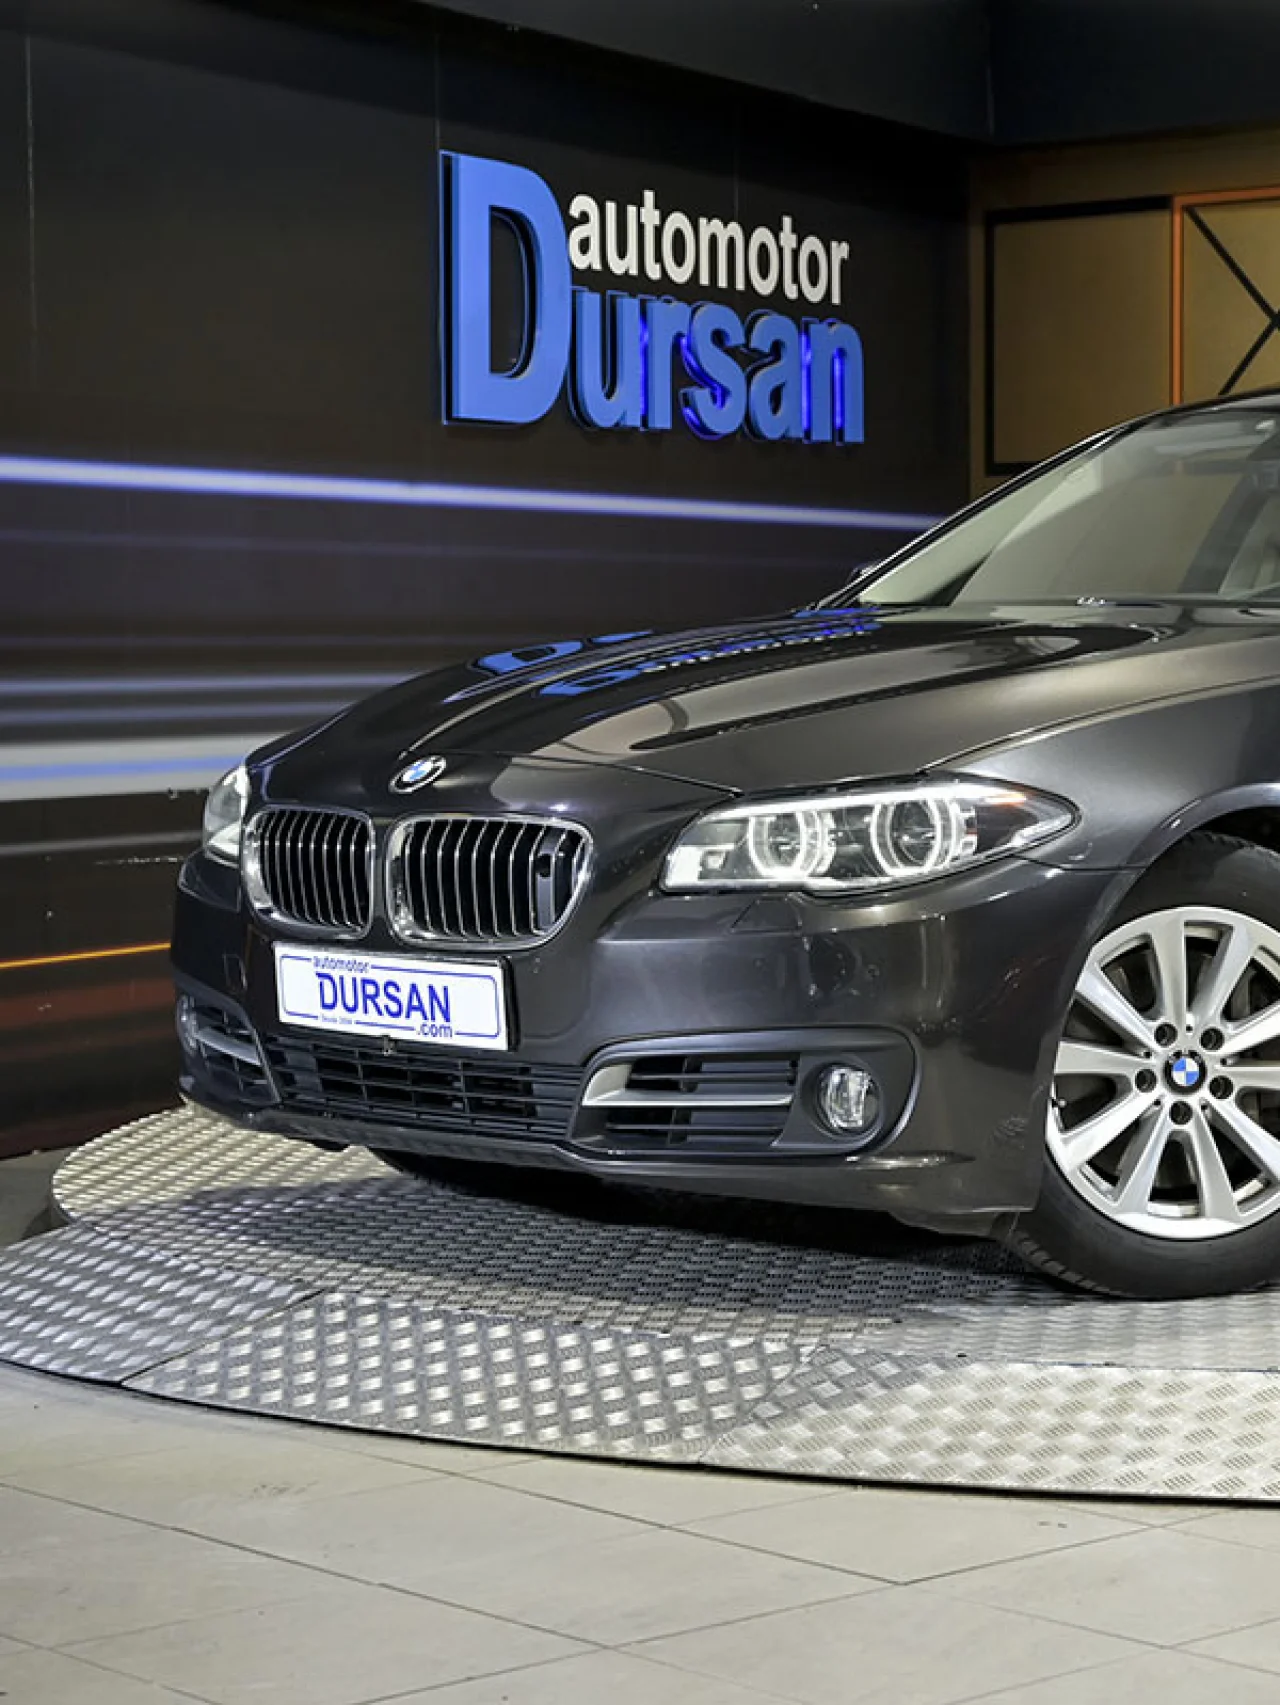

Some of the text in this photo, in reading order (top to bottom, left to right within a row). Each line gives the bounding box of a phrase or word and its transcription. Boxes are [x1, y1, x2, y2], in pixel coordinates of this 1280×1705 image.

[568, 190, 849, 305] automotor
[439, 149, 865, 445] Dursan
[312, 956, 369, 973] automotor
[316, 972, 451, 1023] DURSAN
[416, 1022, 453, 1038] .com
